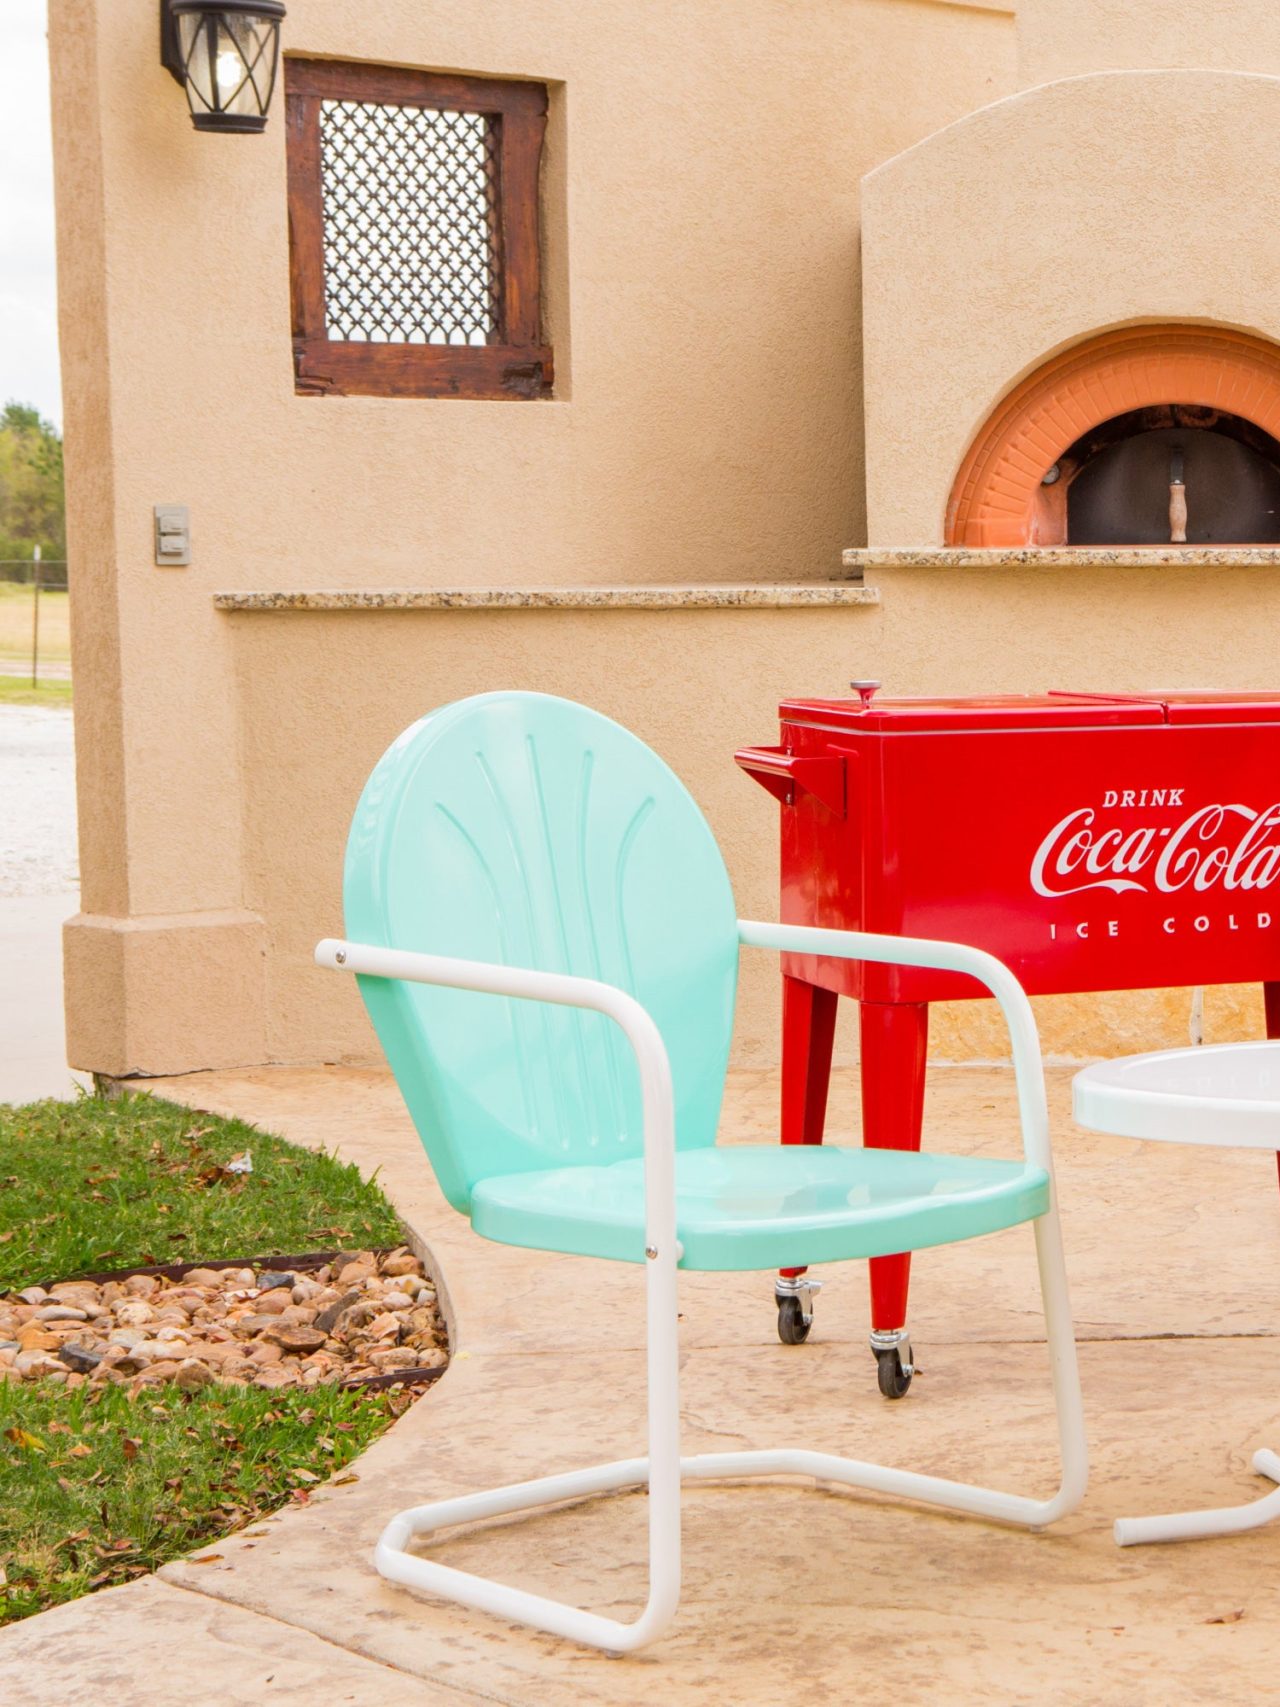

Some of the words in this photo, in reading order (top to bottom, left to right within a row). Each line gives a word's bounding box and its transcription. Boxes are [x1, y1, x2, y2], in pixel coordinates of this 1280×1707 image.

[1102, 788, 1185, 808] DRINK
[1050, 920, 1119, 940] ICE
[1163, 912, 1271, 934] COLD
